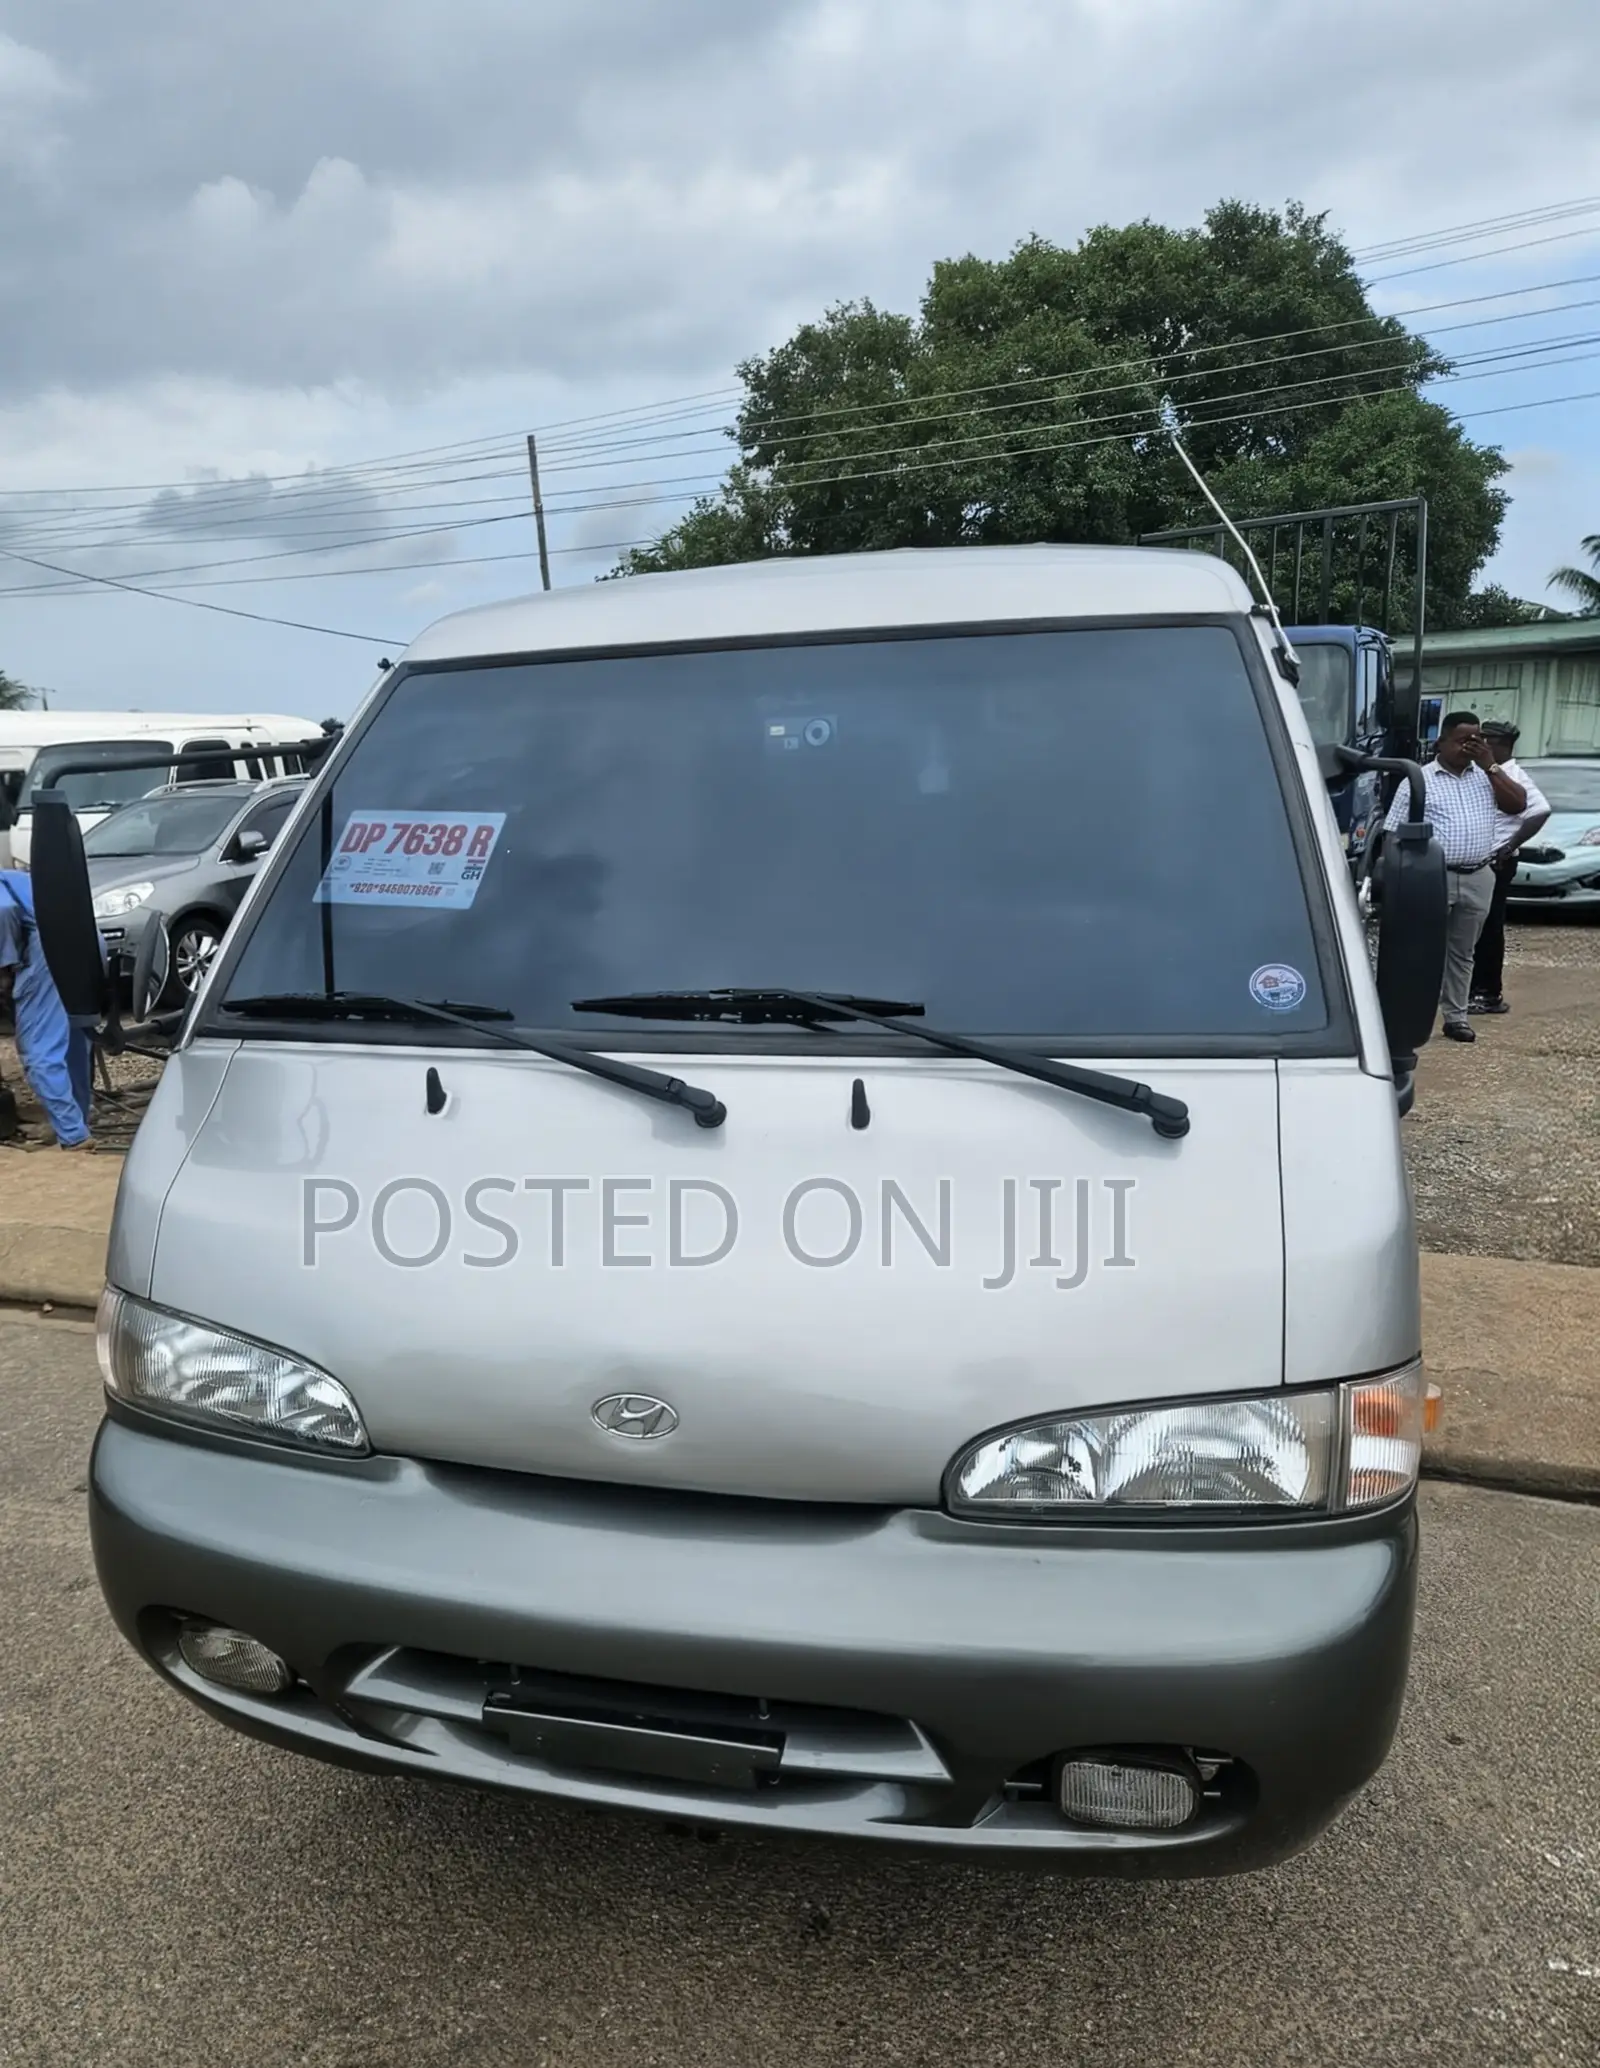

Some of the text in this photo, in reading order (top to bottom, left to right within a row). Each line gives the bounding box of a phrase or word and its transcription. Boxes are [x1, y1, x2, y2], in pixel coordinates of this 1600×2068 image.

[340, 822, 495, 857] DP 7638 R
[460, 870, 481, 880] GH
